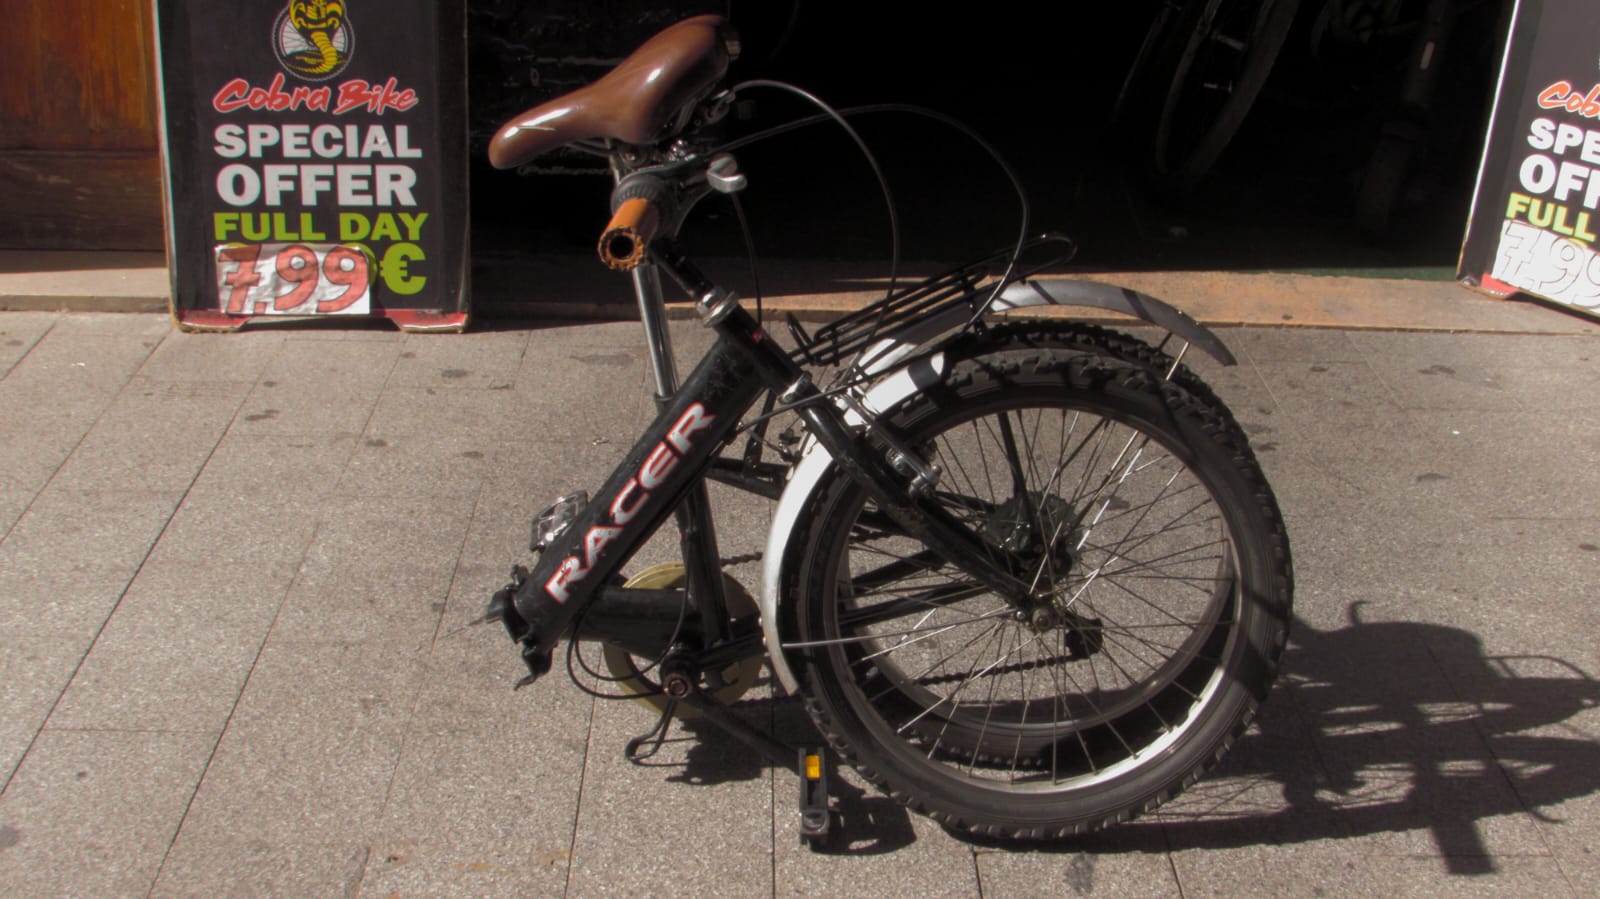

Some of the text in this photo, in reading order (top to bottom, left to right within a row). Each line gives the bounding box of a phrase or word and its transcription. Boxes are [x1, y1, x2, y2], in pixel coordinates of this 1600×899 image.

[213, 73, 418, 115] Cobra Bike
[1537, 80, 1600, 118] Cob
[214, 124, 422, 158] SPECIAL
[1527, 117, 1600, 165] SPE
[216, 164, 417, 206] OFFER
[1519, 154, 1600, 209] OFF
[213, 212, 429, 241] FULL DAY
[1505, 191, 1597, 243] FULL
[544, 402, 716, 604] RACER
